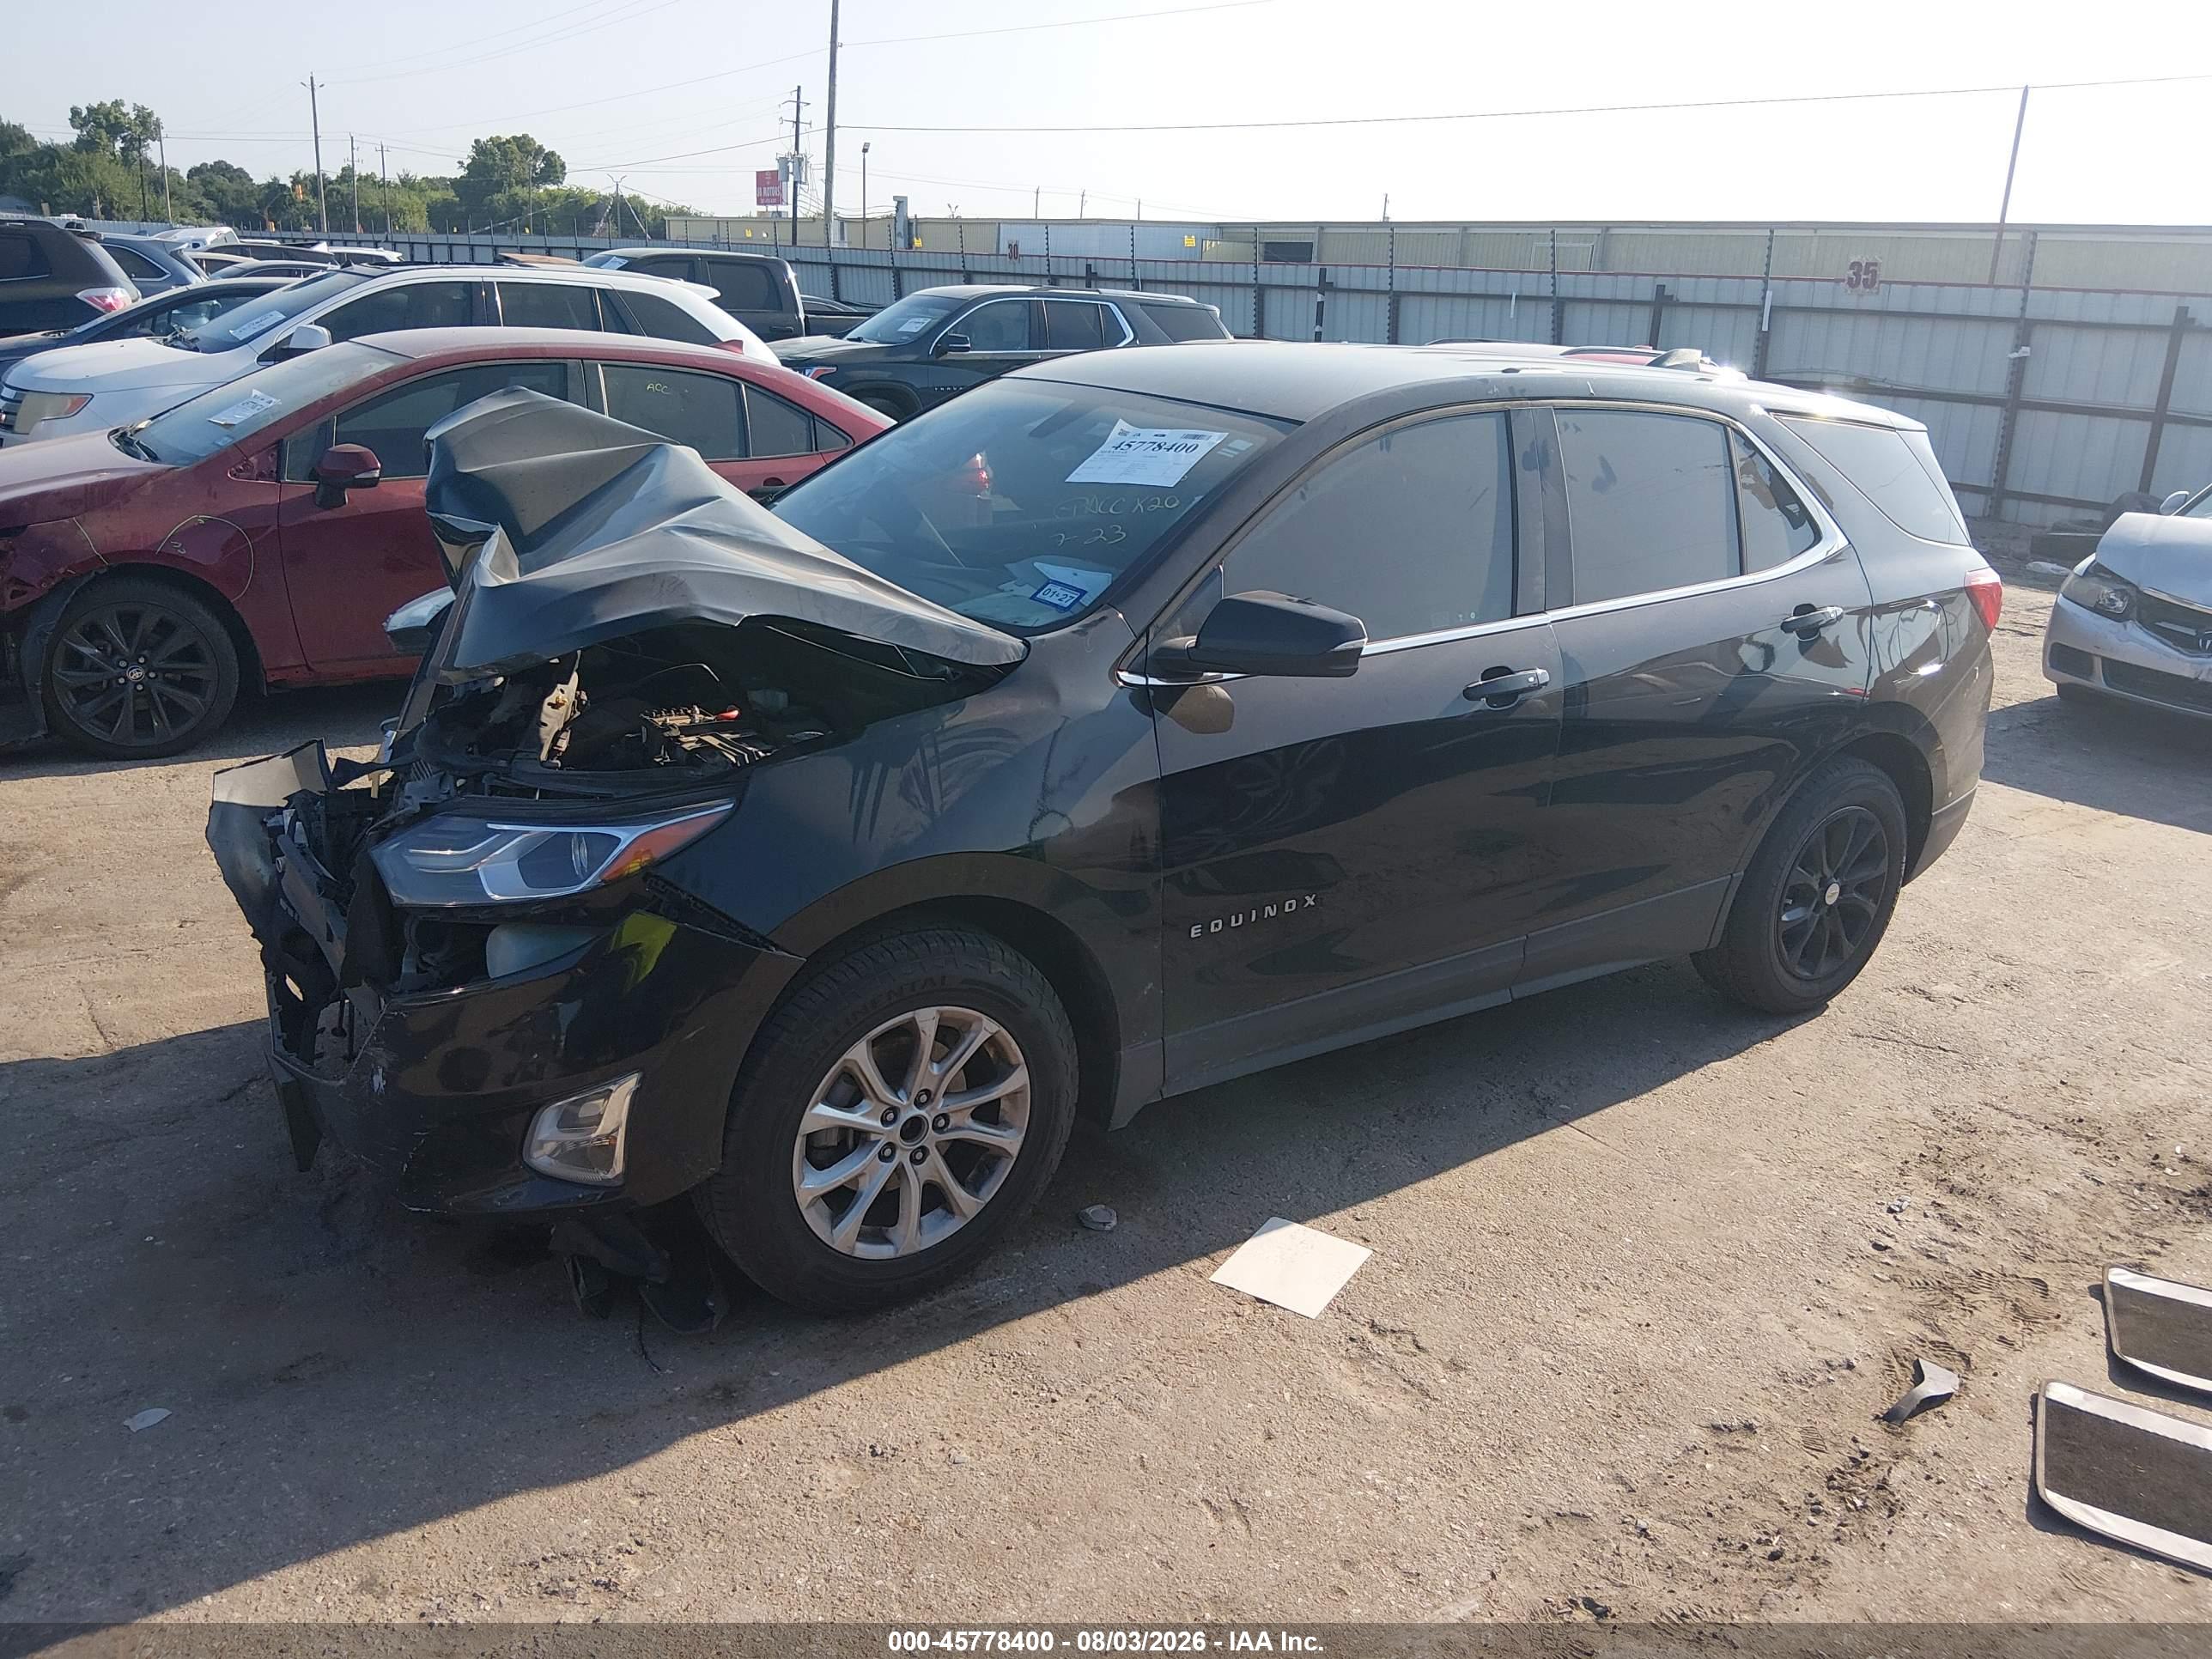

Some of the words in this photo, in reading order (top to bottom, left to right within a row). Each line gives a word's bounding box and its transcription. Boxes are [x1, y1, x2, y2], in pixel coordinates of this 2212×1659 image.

[1008, 244, 1018, 260] 30
[1847, 261, 1878, 289] 35
[647, 383, 672, 395] ACC
[1111, 440, 1200, 454] 45778400
[1190, 893, 1317, 938] EQUINOX
